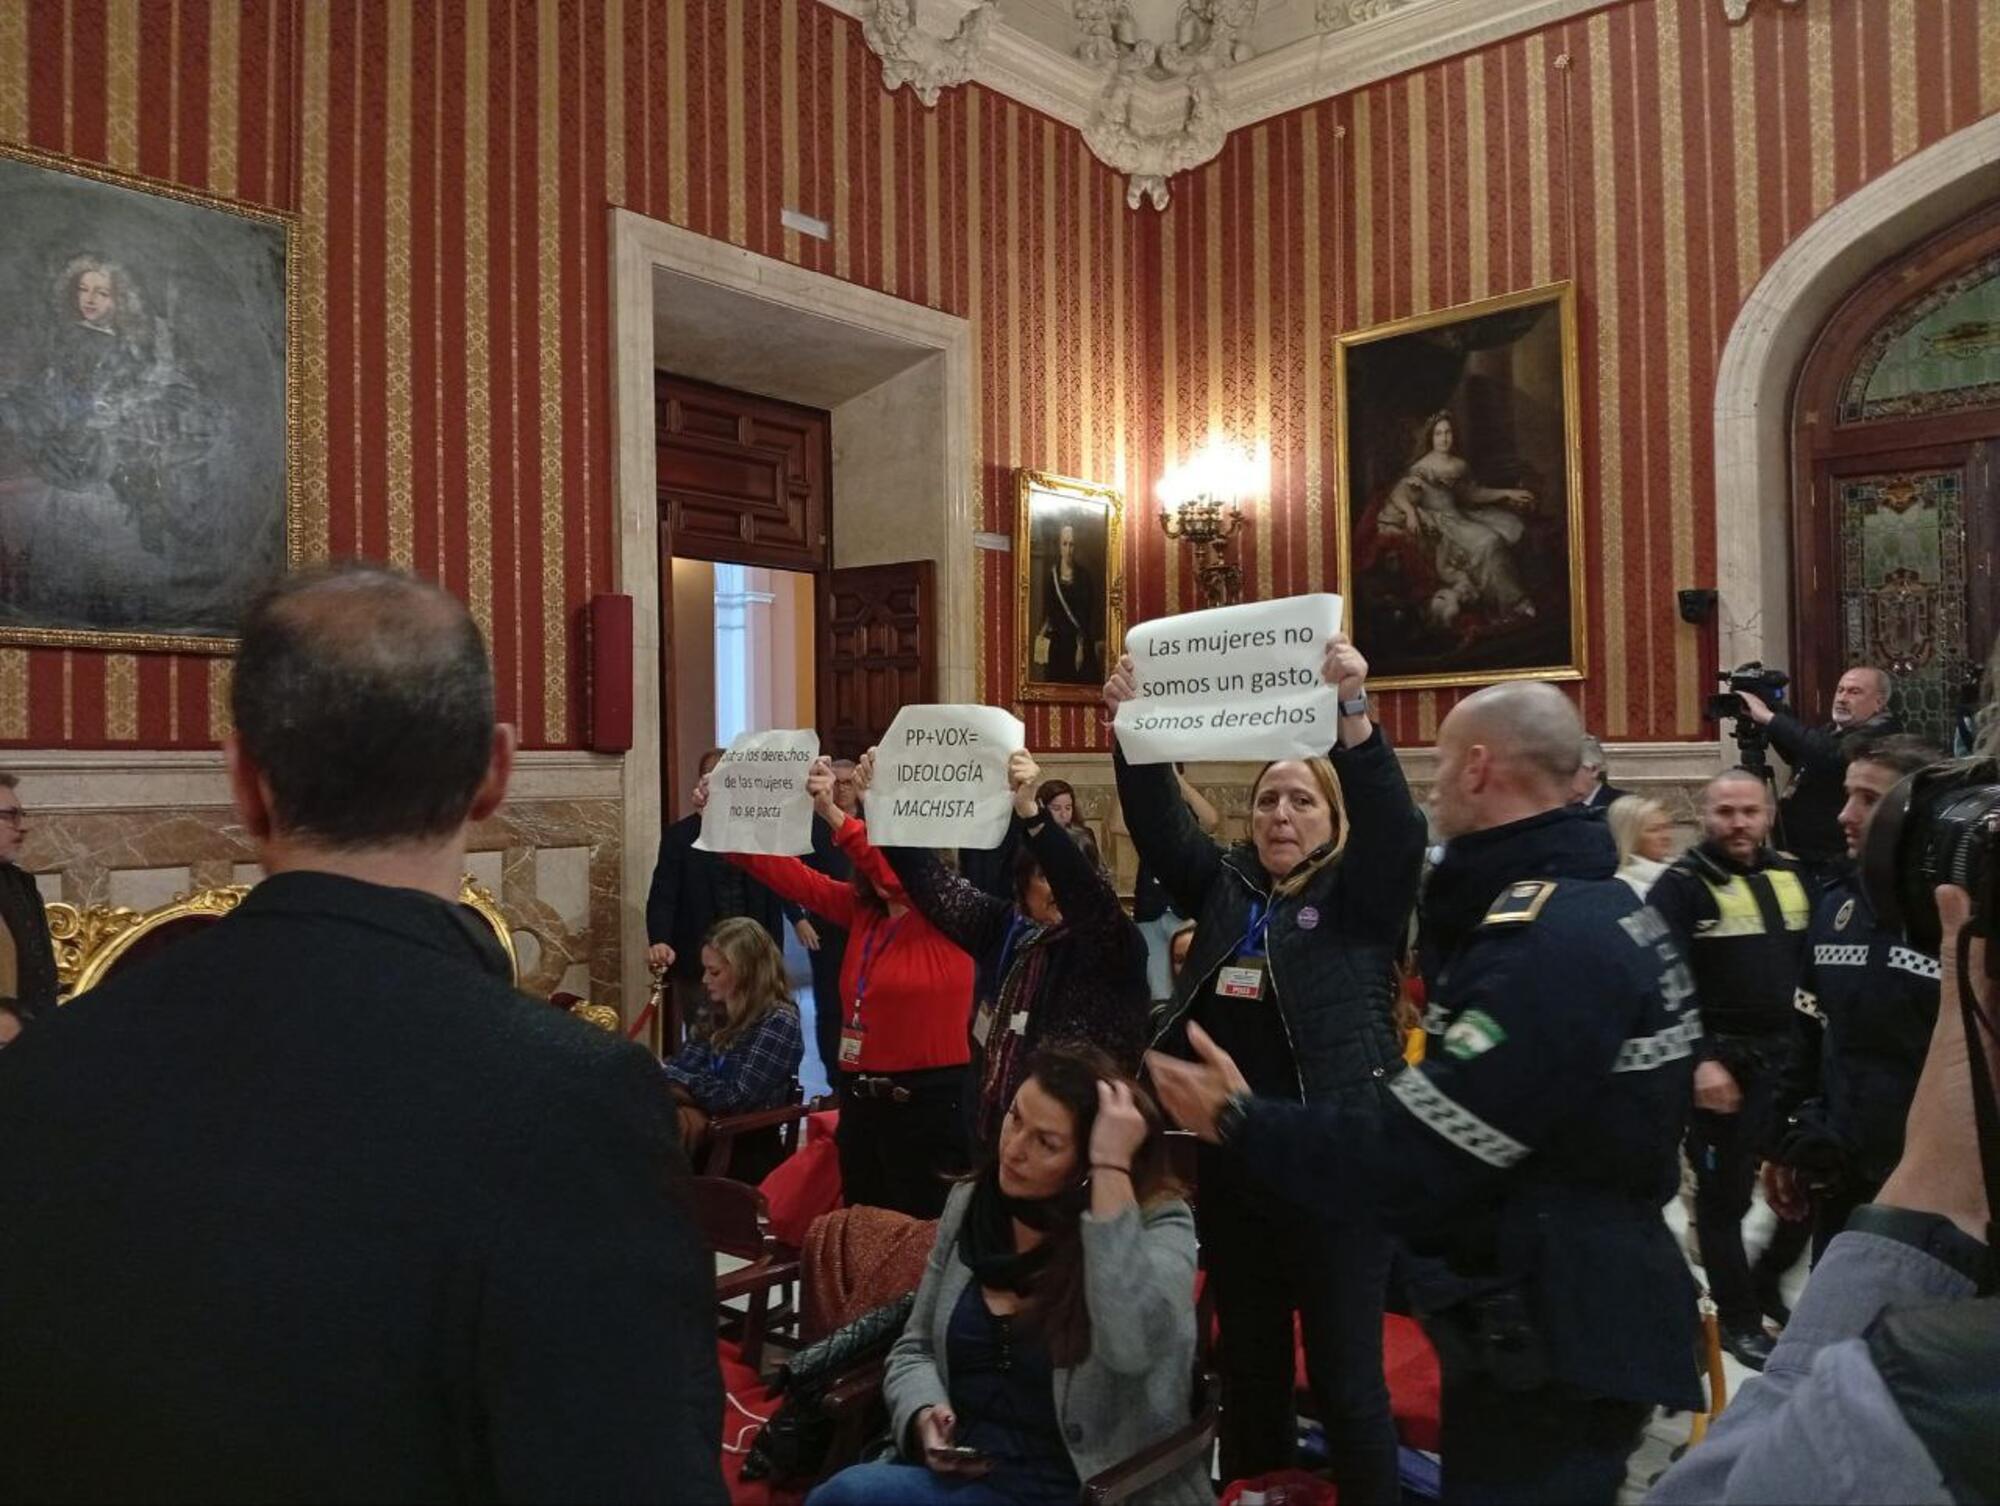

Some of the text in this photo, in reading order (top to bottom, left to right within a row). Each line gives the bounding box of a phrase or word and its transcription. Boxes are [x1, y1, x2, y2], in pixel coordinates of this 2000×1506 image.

[1149, 627, 1313, 657] Las mujeres no
[1142, 666, 1319, 697] somos un gasto,
[1134, 705, 1316, 731] somos derechos
[905, 728, 979, 747] PP+VOX=
[746, 748, 759, 762] los
[760, 746, 811, 762] derechos
[897, 760, 984, 783] IDEOLOGÍA
[724, 775, 794, 792] de las mujeres
[729, 804, 782, 820] no se pacta
[893, 799, 975, 818] MACHISTA
